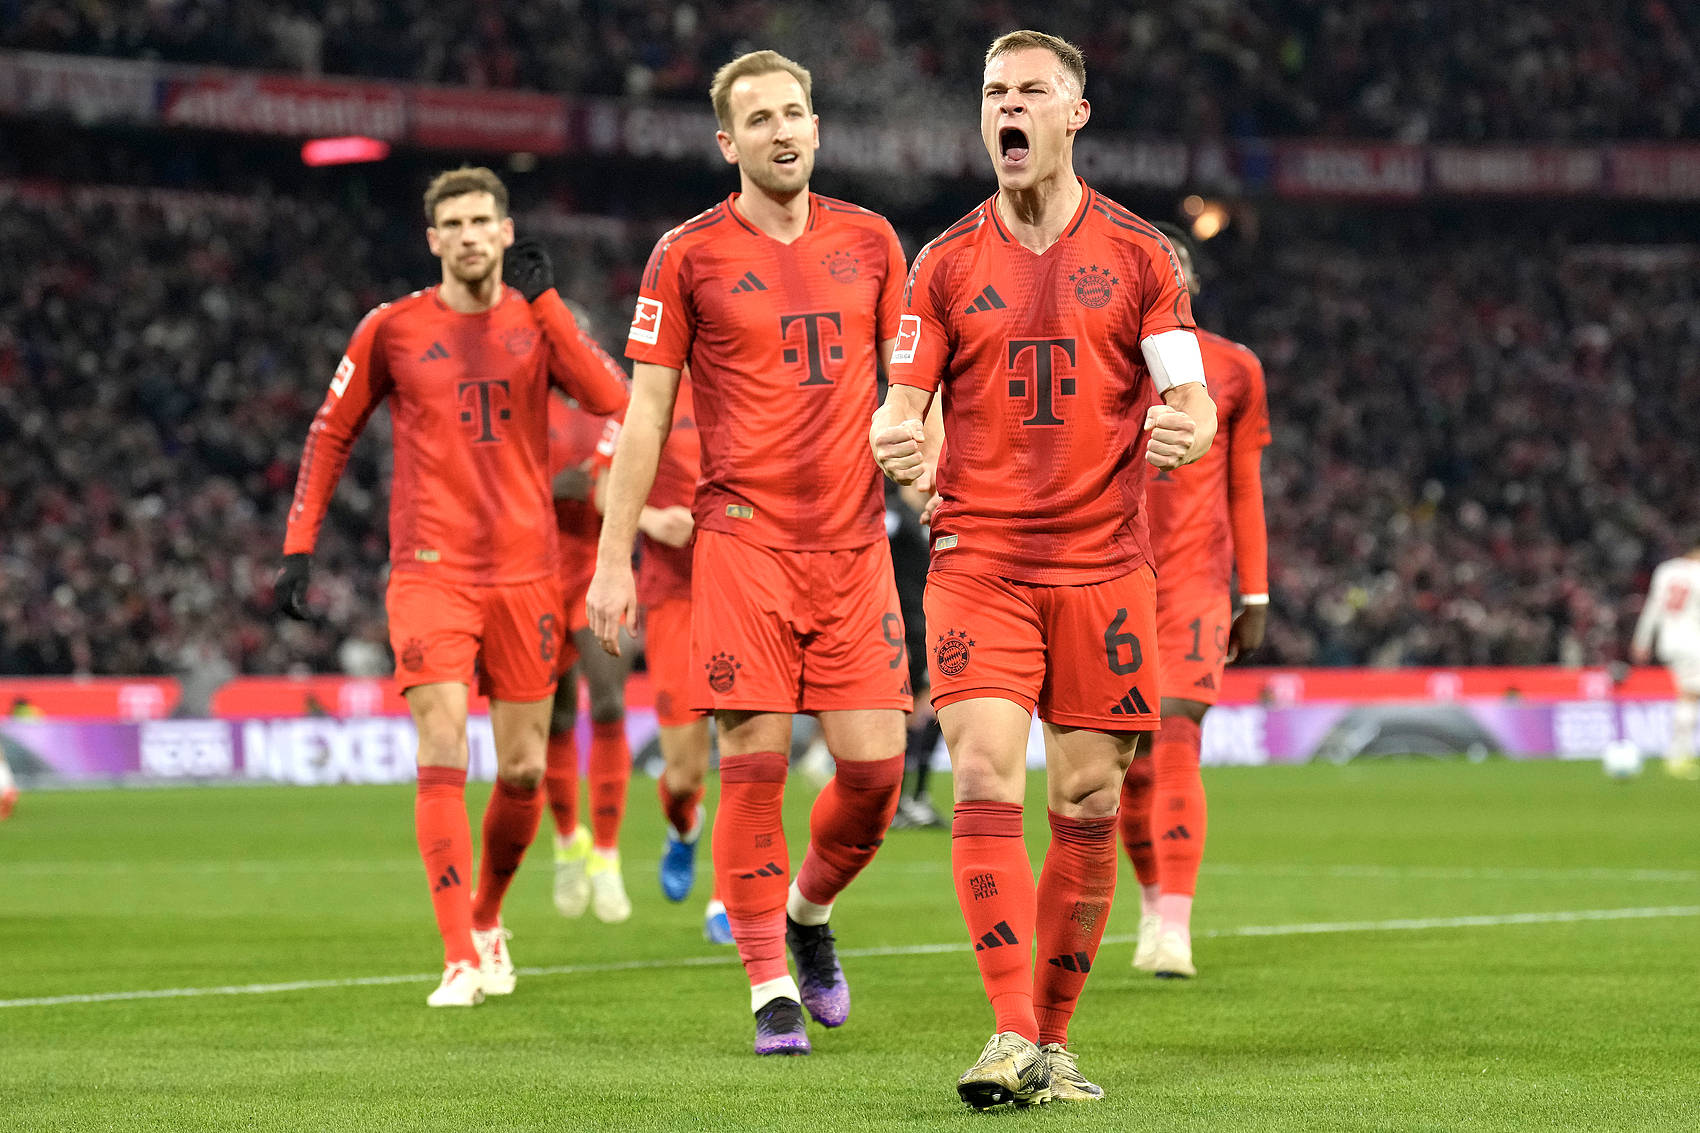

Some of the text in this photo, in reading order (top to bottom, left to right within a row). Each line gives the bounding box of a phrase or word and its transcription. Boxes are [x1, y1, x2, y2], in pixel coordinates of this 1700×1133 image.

[1008, 339, 1076, 426] T
[538, 613, 555, 662] 8
[882, 613, 904, 669] 9
[1104, 608, 1143, 676] 6
[970, 872, 993, 886] MIA
[971, 880, 996, 891] SAN
[974, 888, 998, 901] MIA
